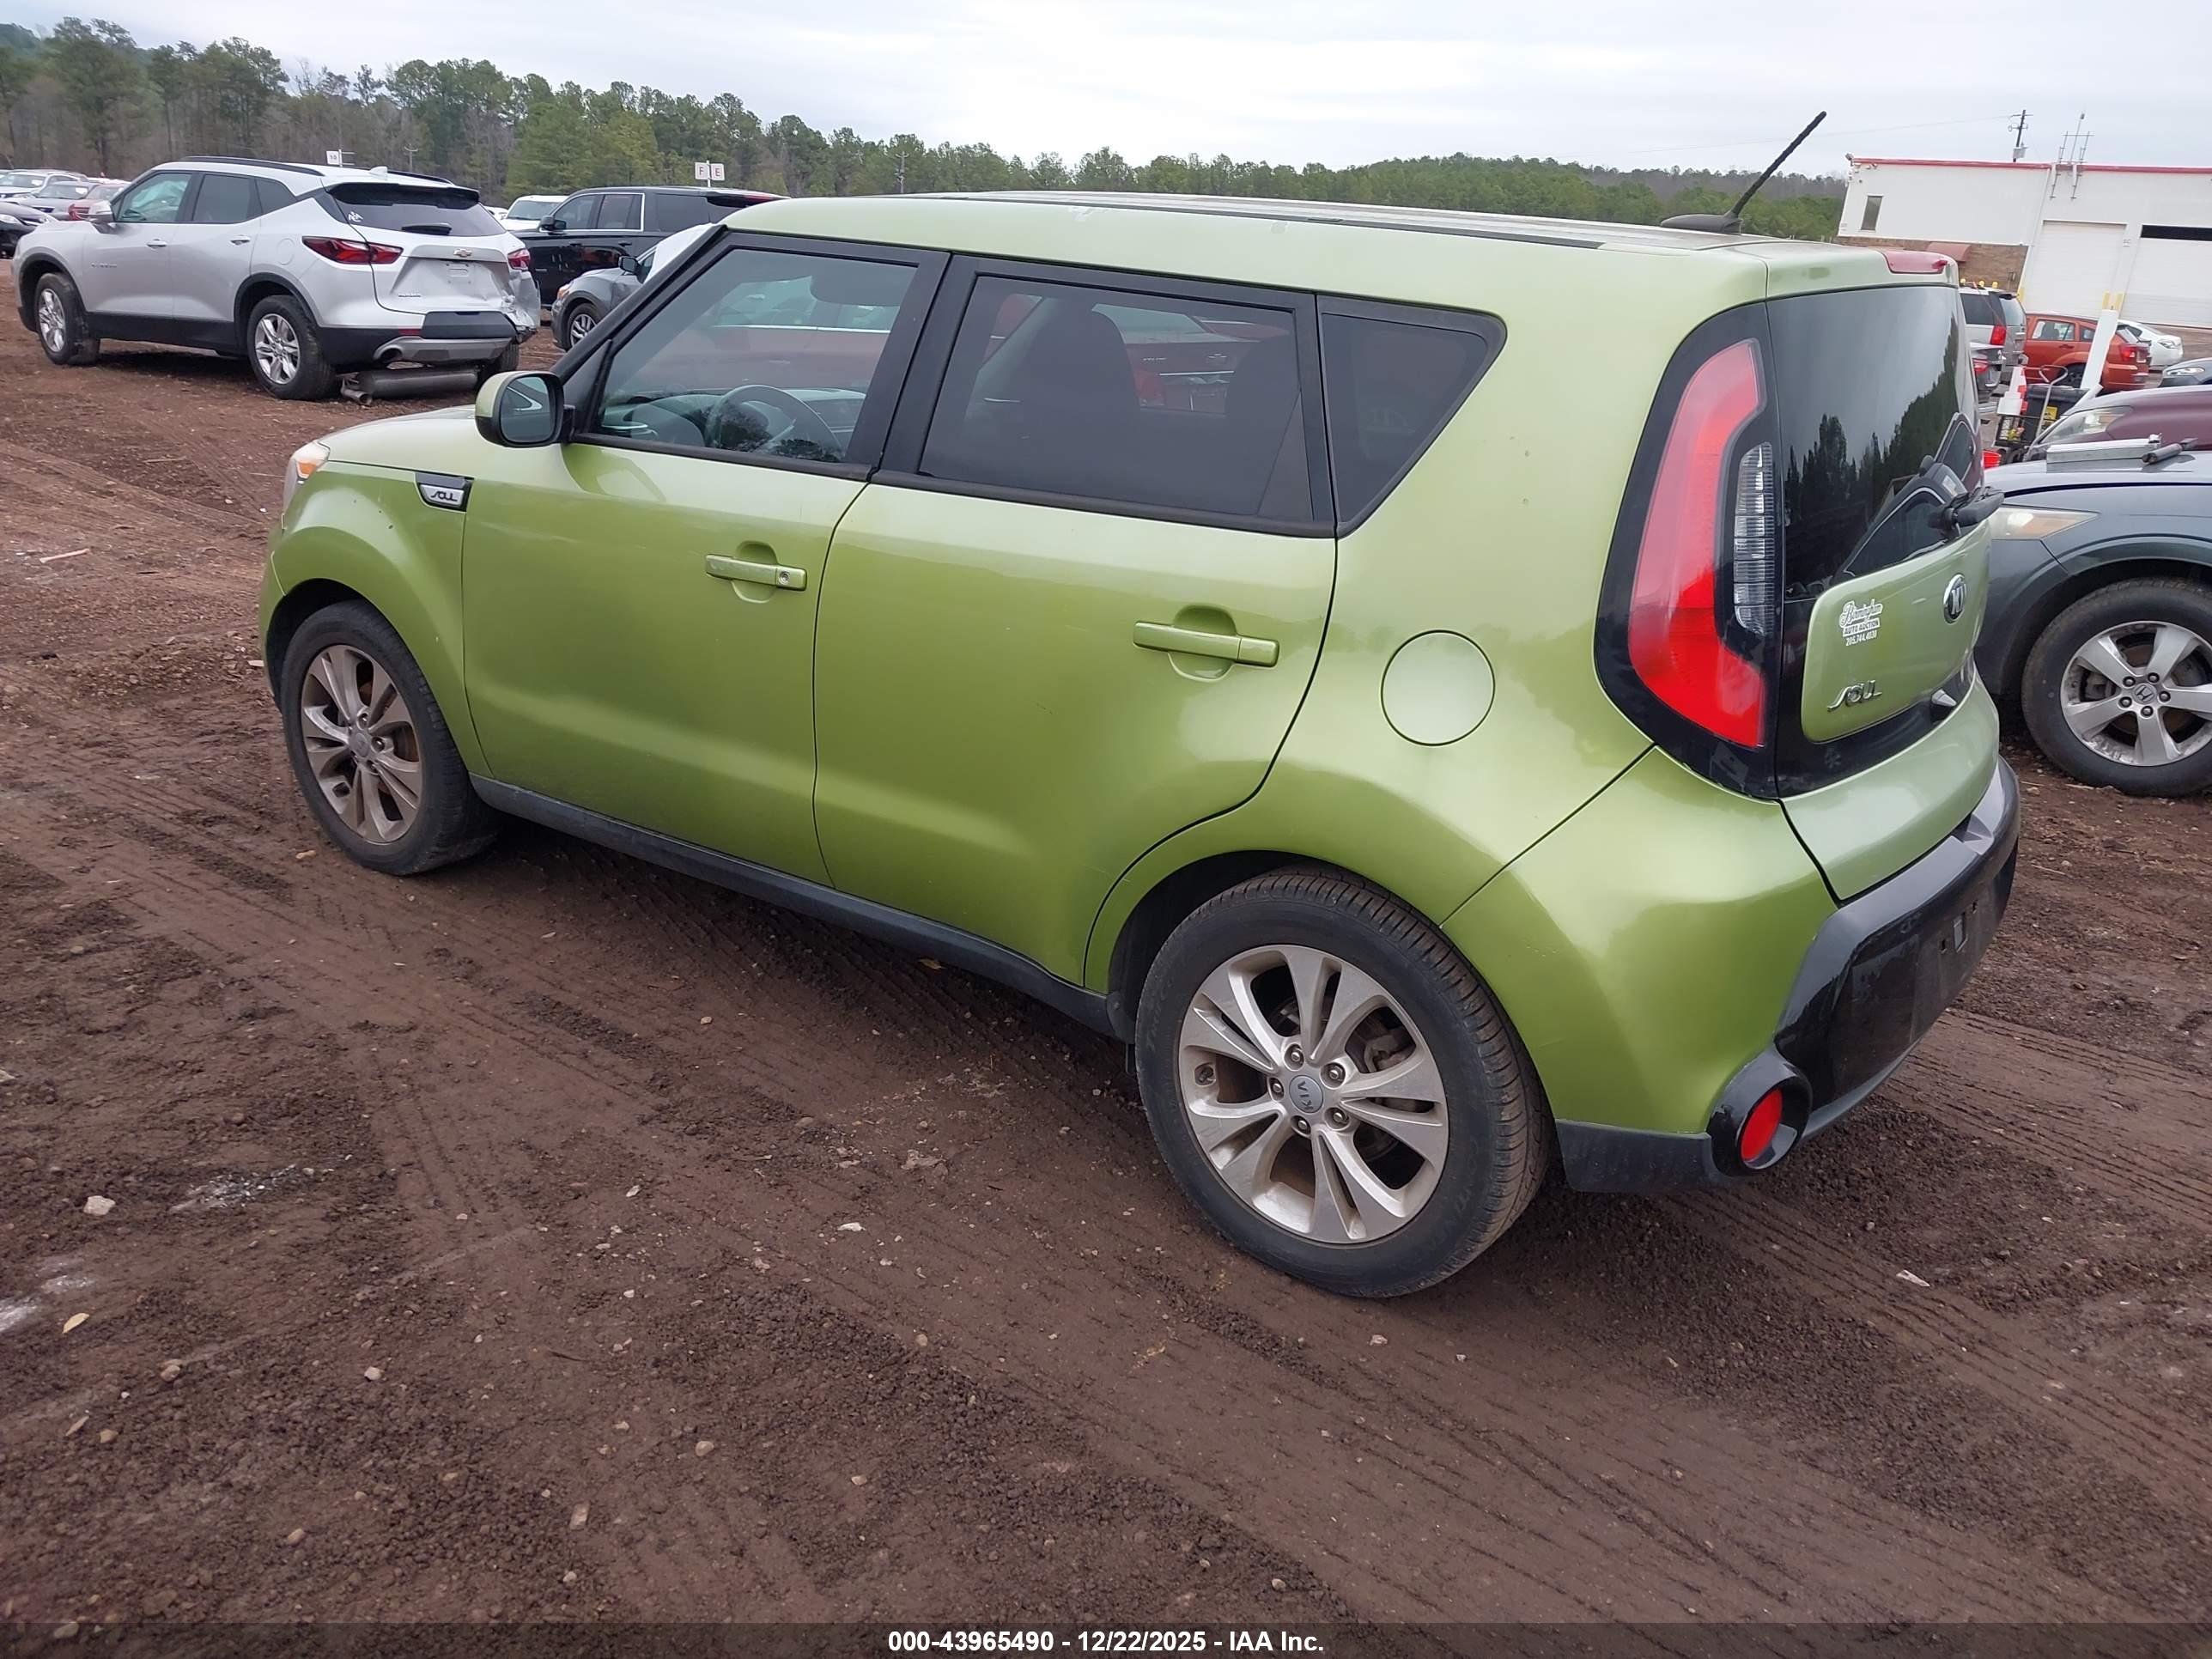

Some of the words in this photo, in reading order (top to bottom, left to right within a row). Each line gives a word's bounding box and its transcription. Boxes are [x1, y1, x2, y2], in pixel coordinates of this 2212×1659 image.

[699, 166, 704, 176] F
[714, 167, 721, 177] E
[1839, 599, 1883, 628] Birmingham
[1844, 625, 1858, 635] AUTO
[1859, 620, 1879, 632] AUCTION
